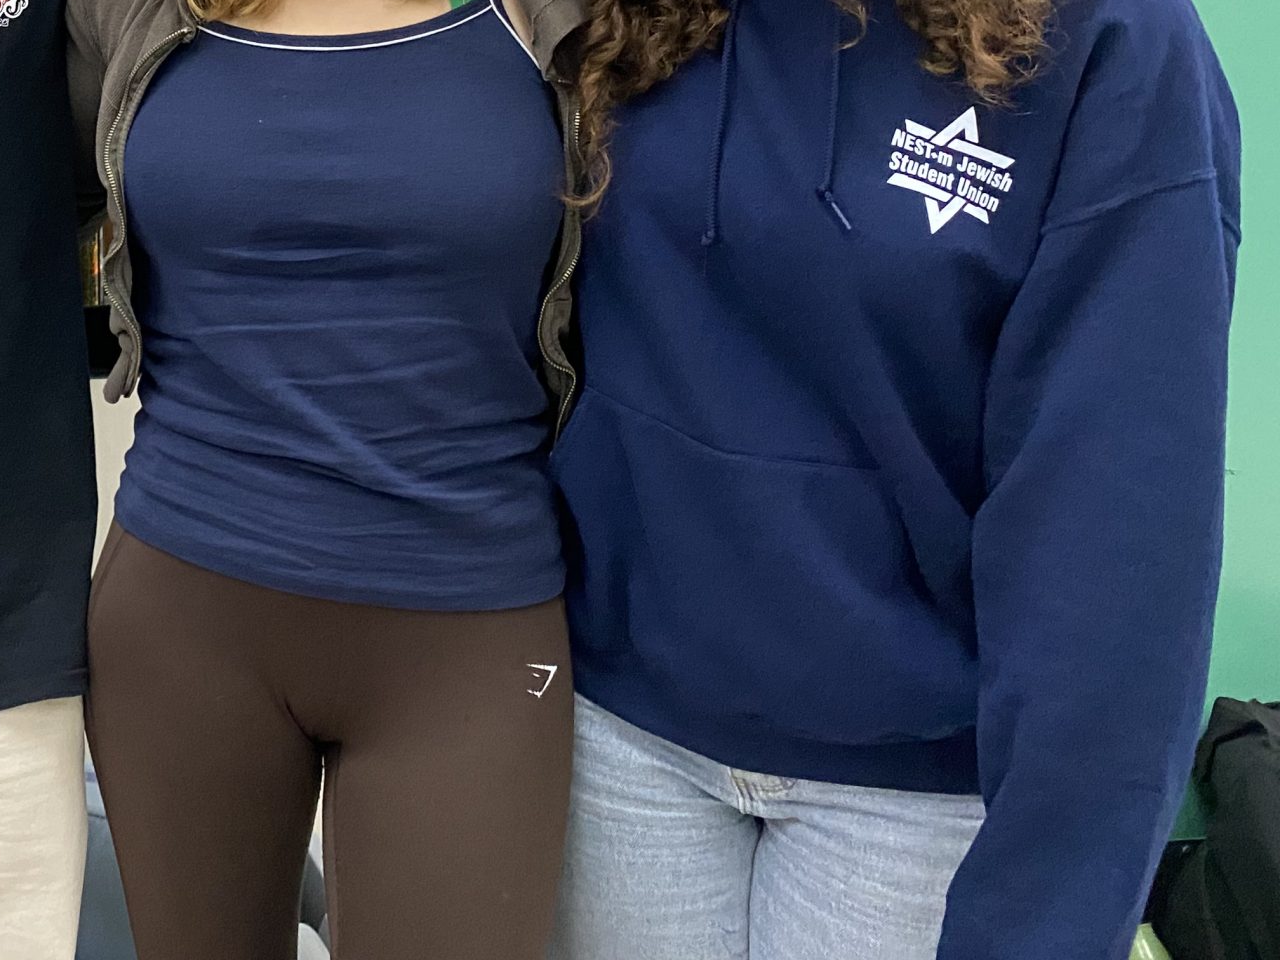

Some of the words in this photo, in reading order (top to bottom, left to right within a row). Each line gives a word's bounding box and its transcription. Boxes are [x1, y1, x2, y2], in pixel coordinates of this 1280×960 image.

[888, 151, 955, 191] Student
[956, 177, 1000, 213] Union
[956, 156, 1014, 193] Jewish
